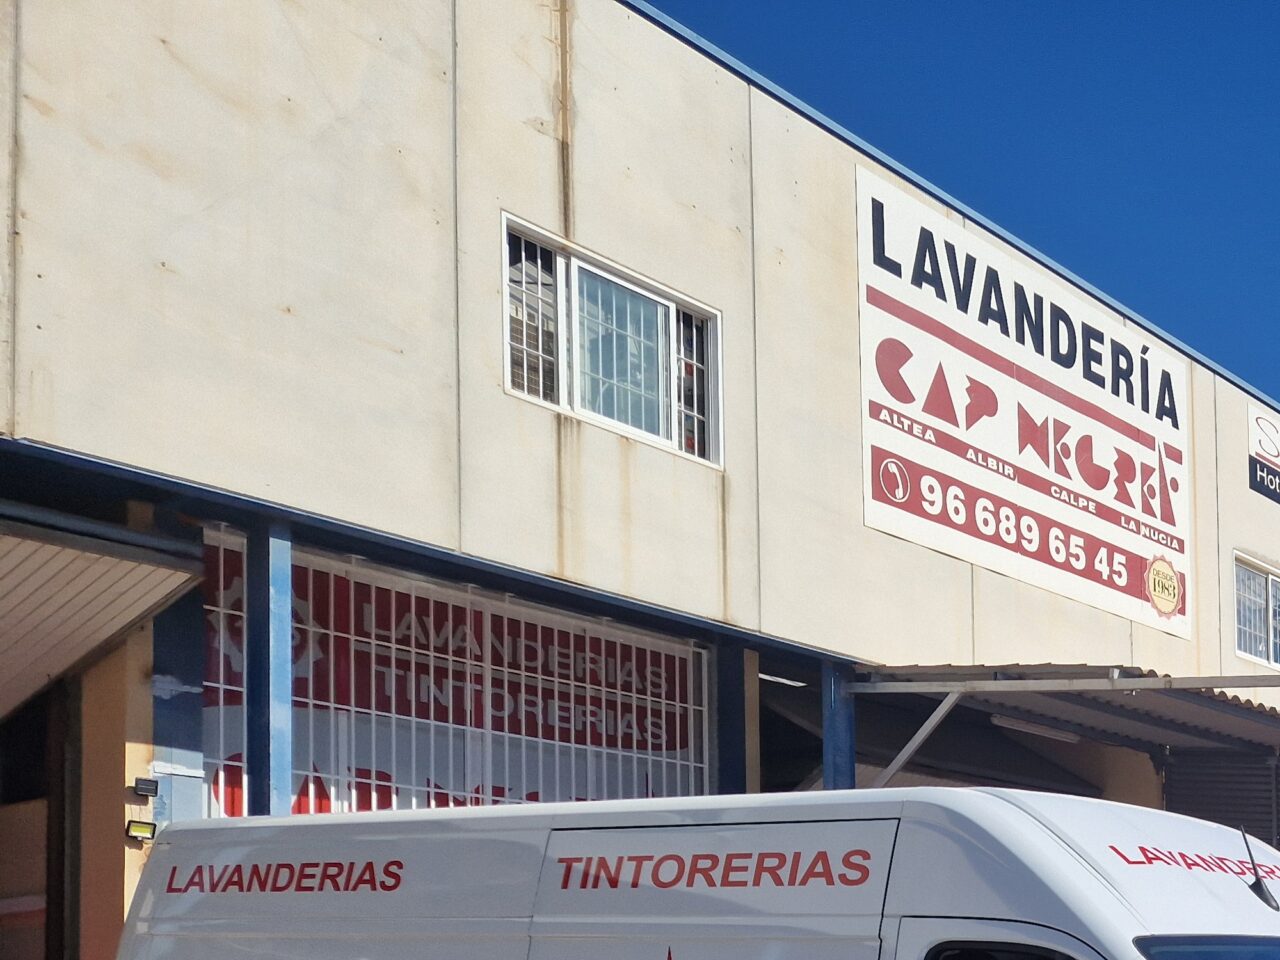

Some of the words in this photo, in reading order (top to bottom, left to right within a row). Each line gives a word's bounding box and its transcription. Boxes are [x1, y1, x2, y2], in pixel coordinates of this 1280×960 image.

[871, 197, 1179, 430] LAVANDERÍA
[875, 338, 998, 431] CAP
[879, 408, 937, 444] ALTEA
[966, 449, 1014, 479] ALBIR
[1050, 486, 1097, 514] CALPE
[1120, 517, 1137, 531] LA
[1141, 524, 1180, 550] NUCIA
[920, 475, 967, 525] 96
[974, 497, 1040, 553] 689
[1048, 527, 1086, 570] 65
[1094, 546, 1128, 587] 45
[1153, 568, 1174, 583] DESDE
[1153, 577, 1176, 599] 1983
[362, 603, 669, 694] LAVANDERIAS
[374, 665, 668, 745] TINTORERIAS
[166, 860, 404, 893] LAVANDERIAS
[557, 849, 872, 890] TINTORERIAS
